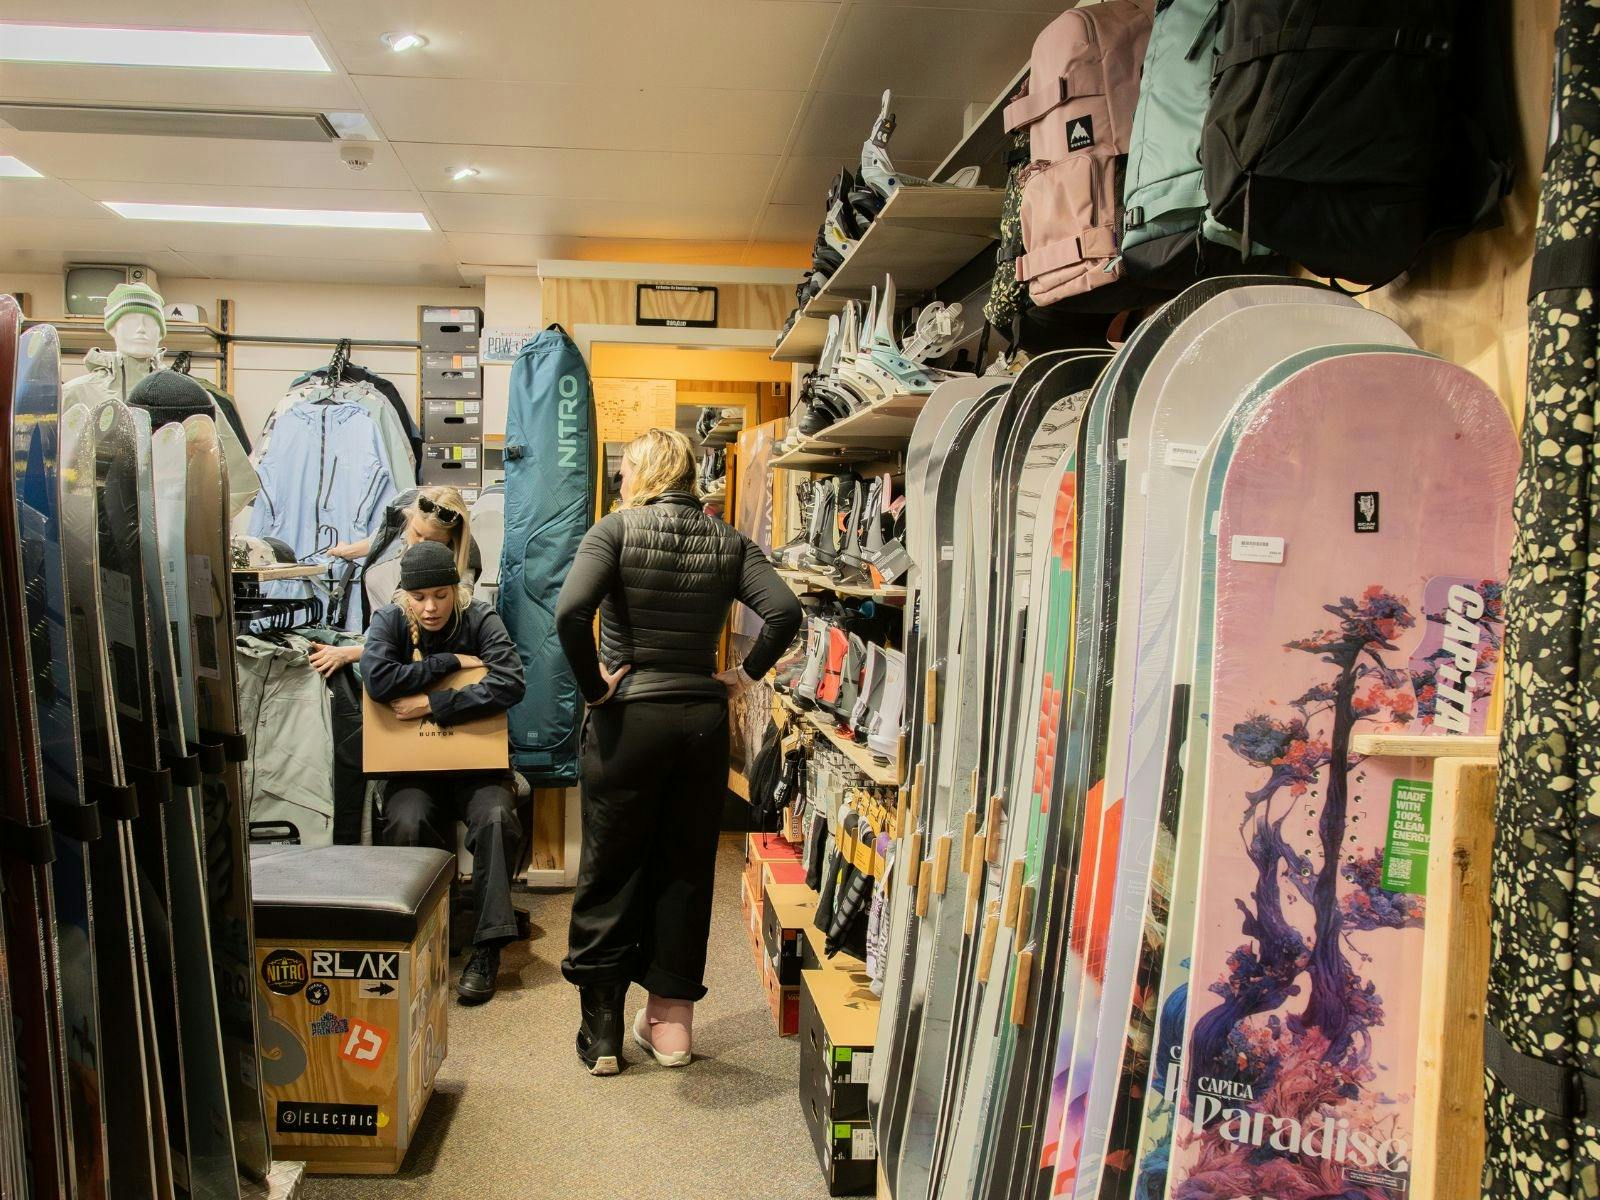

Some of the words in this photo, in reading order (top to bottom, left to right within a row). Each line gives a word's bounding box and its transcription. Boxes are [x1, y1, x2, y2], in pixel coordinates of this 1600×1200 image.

[557, 374, 578, 468] NITRO
[1397, 790, 1426, 803] MADE
[1396, 800, 1421, 811] WITH
[1395, 810, 1423, 822] 100%
[1393, 820, 1425, 833] CLEAN
[266, 962, 305, 982] NITRO
[313, 951, 397, 979] BLAK
[304, 1112, 374, 1126] ELECTRIC
[1192, 1093, 1409, 1173] Paradise
